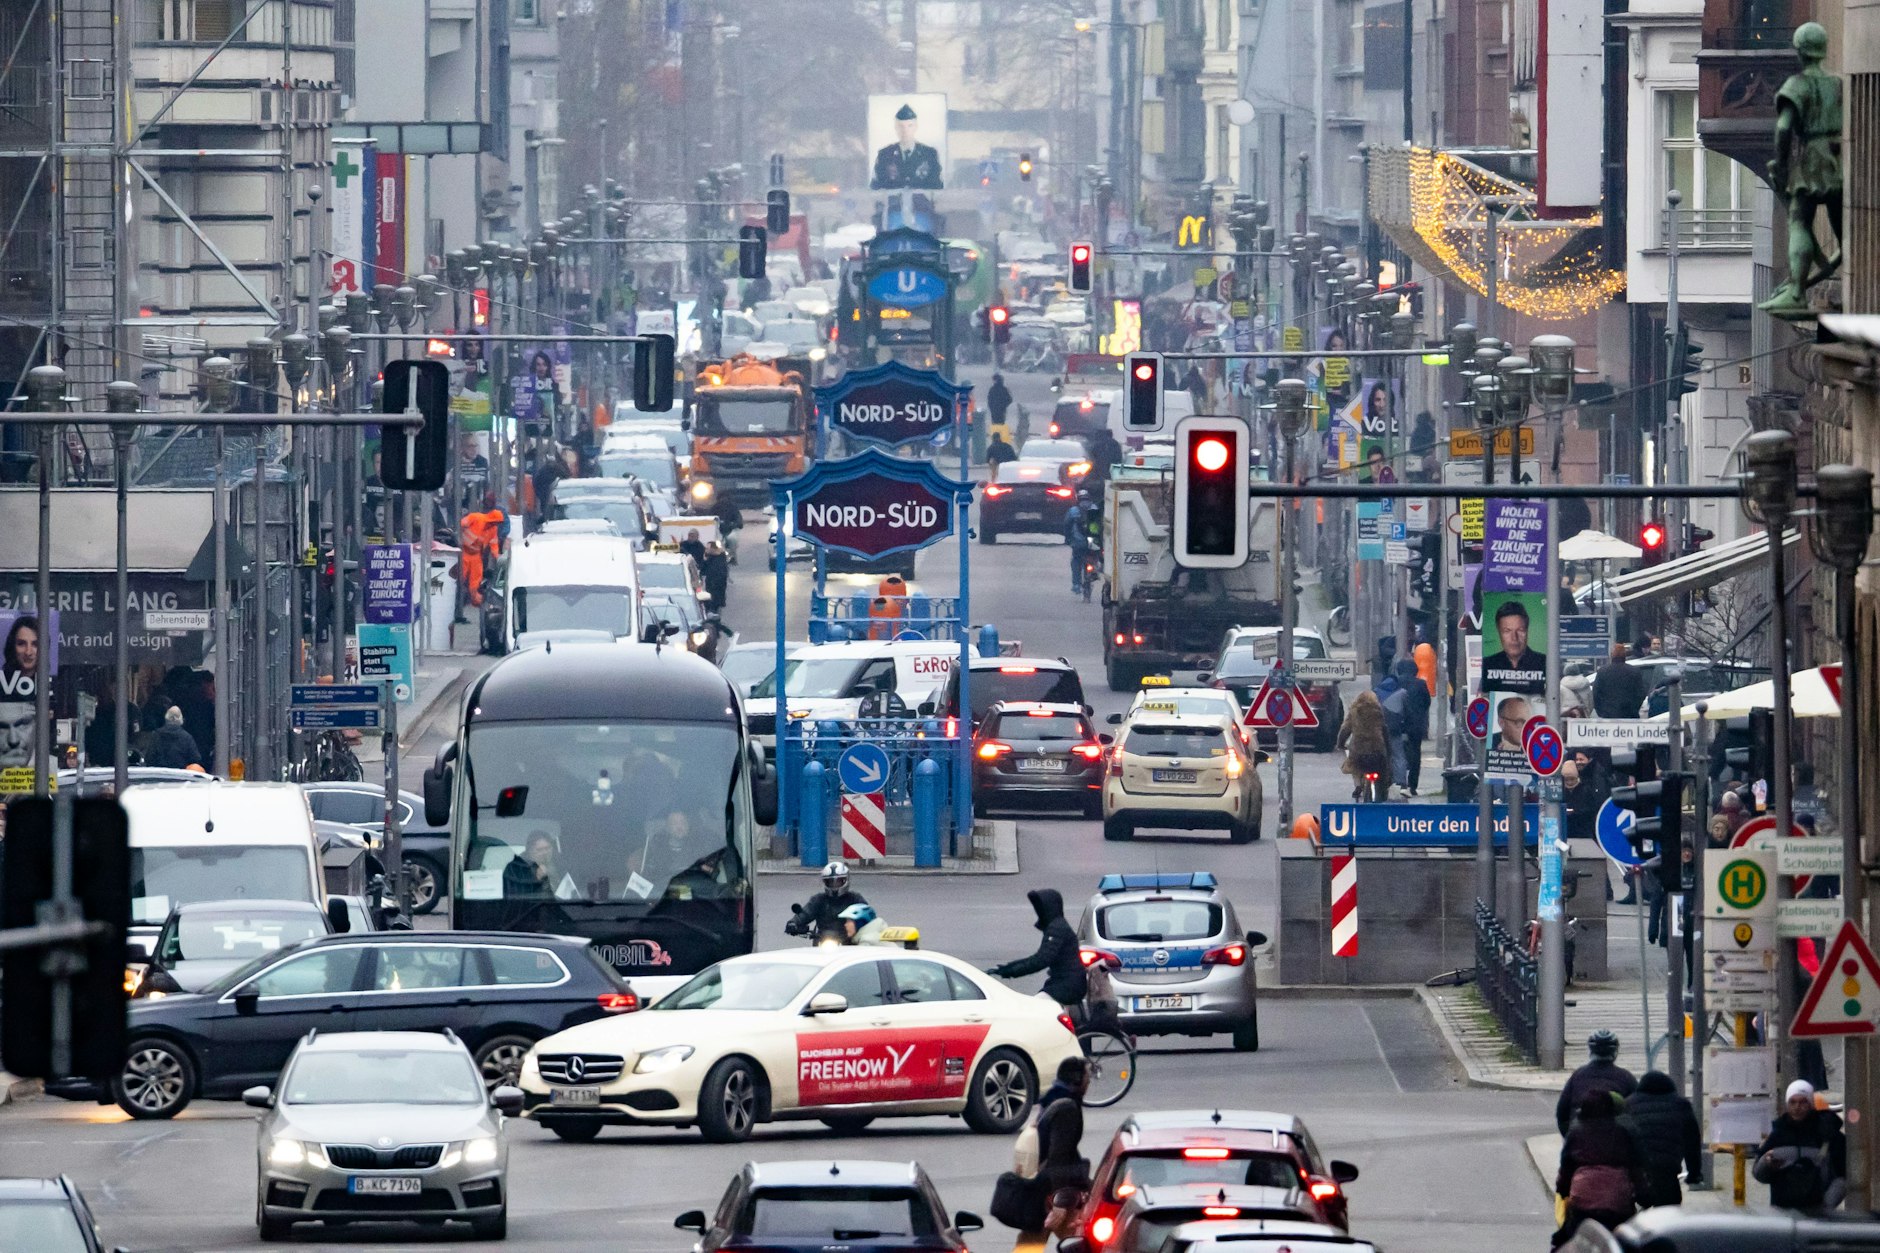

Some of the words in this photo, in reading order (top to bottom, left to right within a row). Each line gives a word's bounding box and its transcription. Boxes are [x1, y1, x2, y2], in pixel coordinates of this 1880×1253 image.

[898, 271, 916, 292] U
[840, 401, 943, 422] NORD-SÜD
[1364, 416, 1398, 433] Vot
[806, 500, 938, 528] NORD-SÜD
[1501, 506, 1539, 518] HOLEN
[1496, 517, 1518, 528] WIR
[1519, 519, 1542, 530] UNS
[1392, 524, 1402, 538] P
[1508, 529, 1528, 541] DIE
[1491, 540, 1544, 554] ZUKUNFT
[373, 550, 401, 559] HOLEN
[1493, 551, 1540, 565] ZURÜCK
[371, 560, 386, 569] WIR
[386, 559, 405, 569] UNS
[379, 569, 394, 579] DIE
[1505, 575, 1524, 586] Volt
[369, 580, 407, 590] ZUKUNFT
[371, 588, 405, 599] ZURÜCK
[0, 591, 94, 612] GERIE
[150, 611, 206, 625] Behrenstraße
[58, 632, 78, 647] Art
[83, 632, 113, 647] and
[126, 632, 172, 651] esign
[362, 648, 395, 656] Stabilität
[1294, 663, 1351, 676] Behrenstraße
[1487, 669, 1546, 681] ZUVERSICHT.
[0, 670, 53, 696] Vol
[1577, 725, 1609, 738] Unter
[1612, 725, 1634, 738] den
[1636, 724, 1671, 738] Linde
[1329, 811, 1349, 837] U
[1388, 816, 1433, 832] Unter
[1439, 816, 1469, 832] den
[1476, 816, 1530, 832] Lndn
[1783, 858, 1842, 869] Schloßplat
[1732, 871, 1753, 897] H
[1123, 957, 1155, 965] POLIZE
[1145, 998, 1152, 1008] B
[1159, 998, 1183, 1007] 7122
[800, 1050, 843, 1058] BUCHBAR
[800, 1060, 887, 1080] FREENOW
[356, 1180, 364, 1190] B
[371, 1179, 387, 1190] KC
[390, 1180, 419, 1190] 7196
